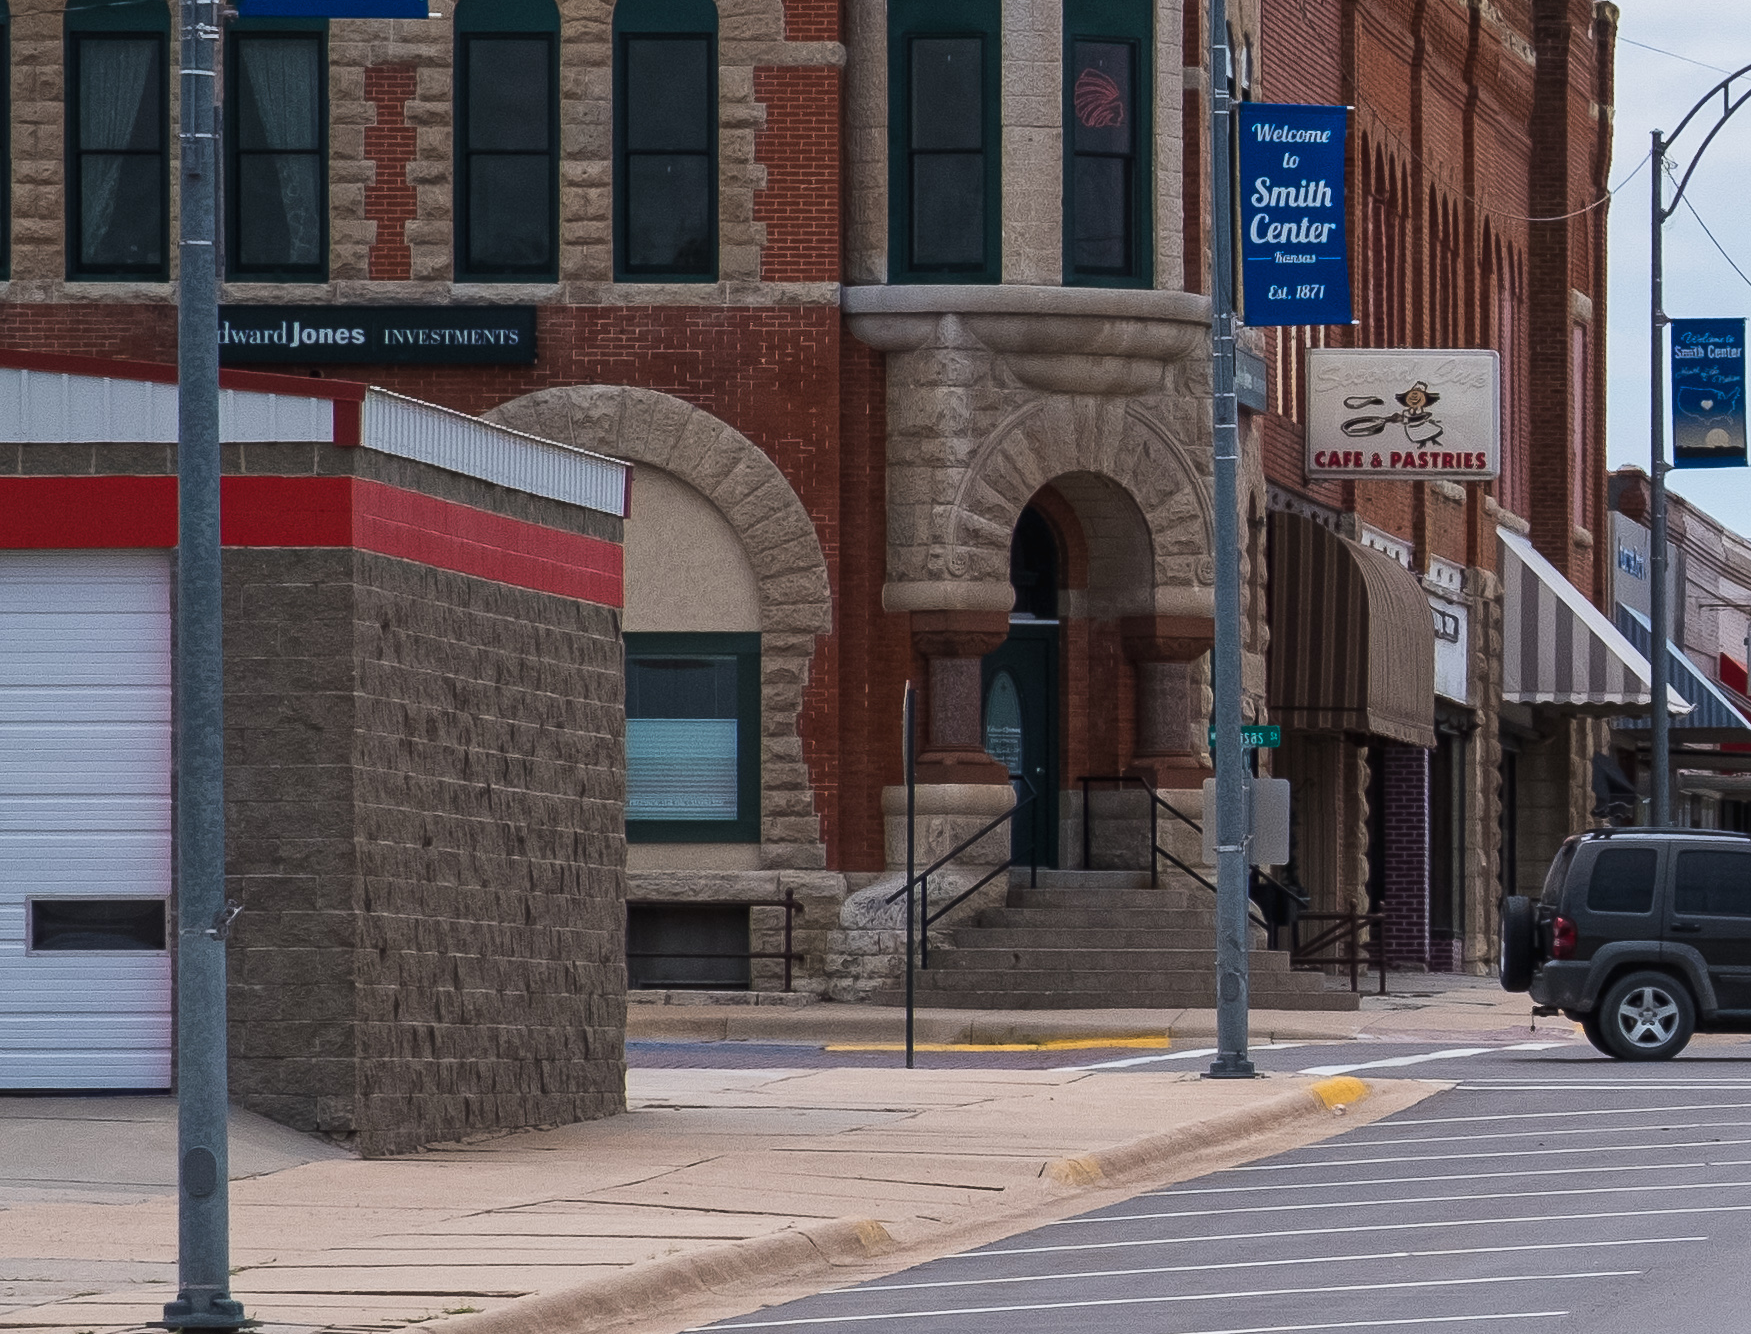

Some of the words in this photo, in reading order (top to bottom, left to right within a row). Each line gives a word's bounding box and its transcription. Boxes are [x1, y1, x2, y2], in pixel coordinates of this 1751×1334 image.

[1251, 123, 1332, 143] Welcome
[1282, 152, 1300, 169] to
[1251, 177, 1333, 207] Smith
[1250, 213, 1336, 244] Center
[1274, 251, 1317, 263] Kansas
[1296, 284, 1325, 299] 1871
[218, 321, 287, 345] dward
[290, 321, 365, 348] Jones
[384, 328, 519, 345] INVESTMENTS
[1675, 345, 1704, 359] Smith
[1708, 345, 1742, 358] Center
[1315, 451, 1363, 468] CAFE
[1370, 452, 1383, 468] &
[1390, 451, 1487, 469] PASTRIES
